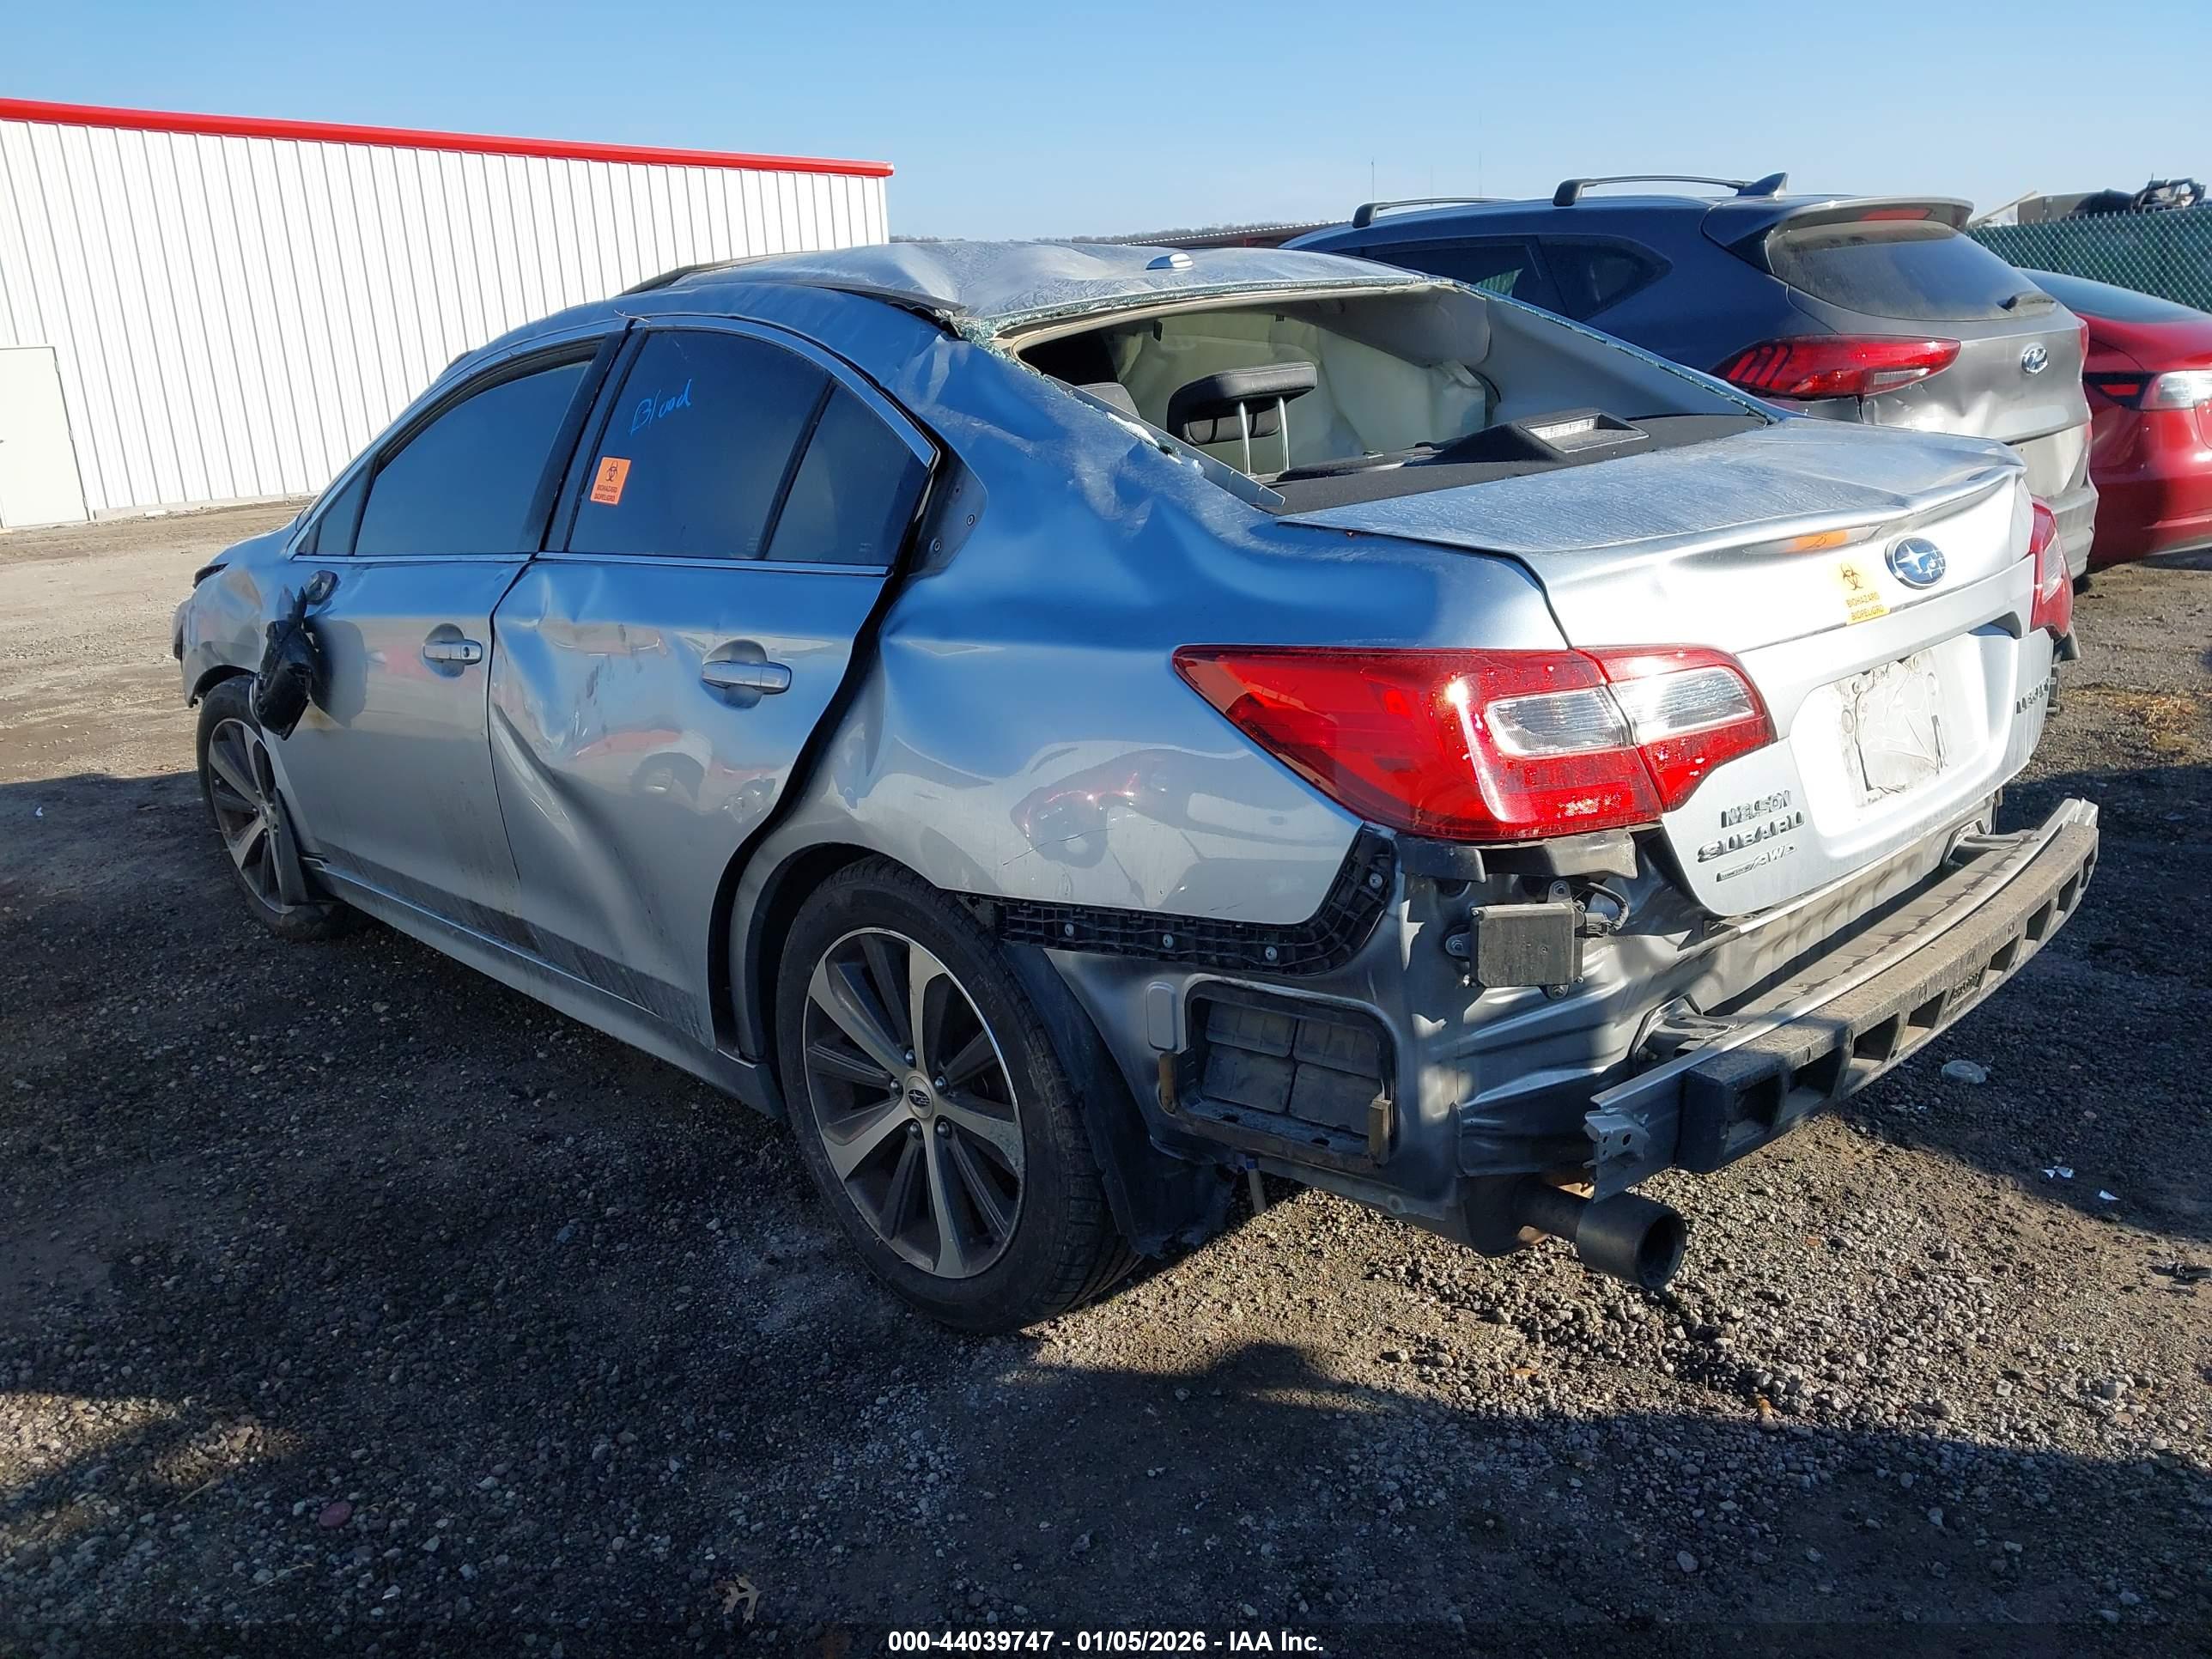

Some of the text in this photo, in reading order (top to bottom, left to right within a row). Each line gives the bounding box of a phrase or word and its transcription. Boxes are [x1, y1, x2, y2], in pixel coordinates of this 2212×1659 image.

[629, 378, 693, 436] Blood
[1845, 591, 1881, 608] BIOHAZARD
[1850, 604, 1885, 621] BIOPELIGRO
[1697, 811, 1805, 863] SUBARU
